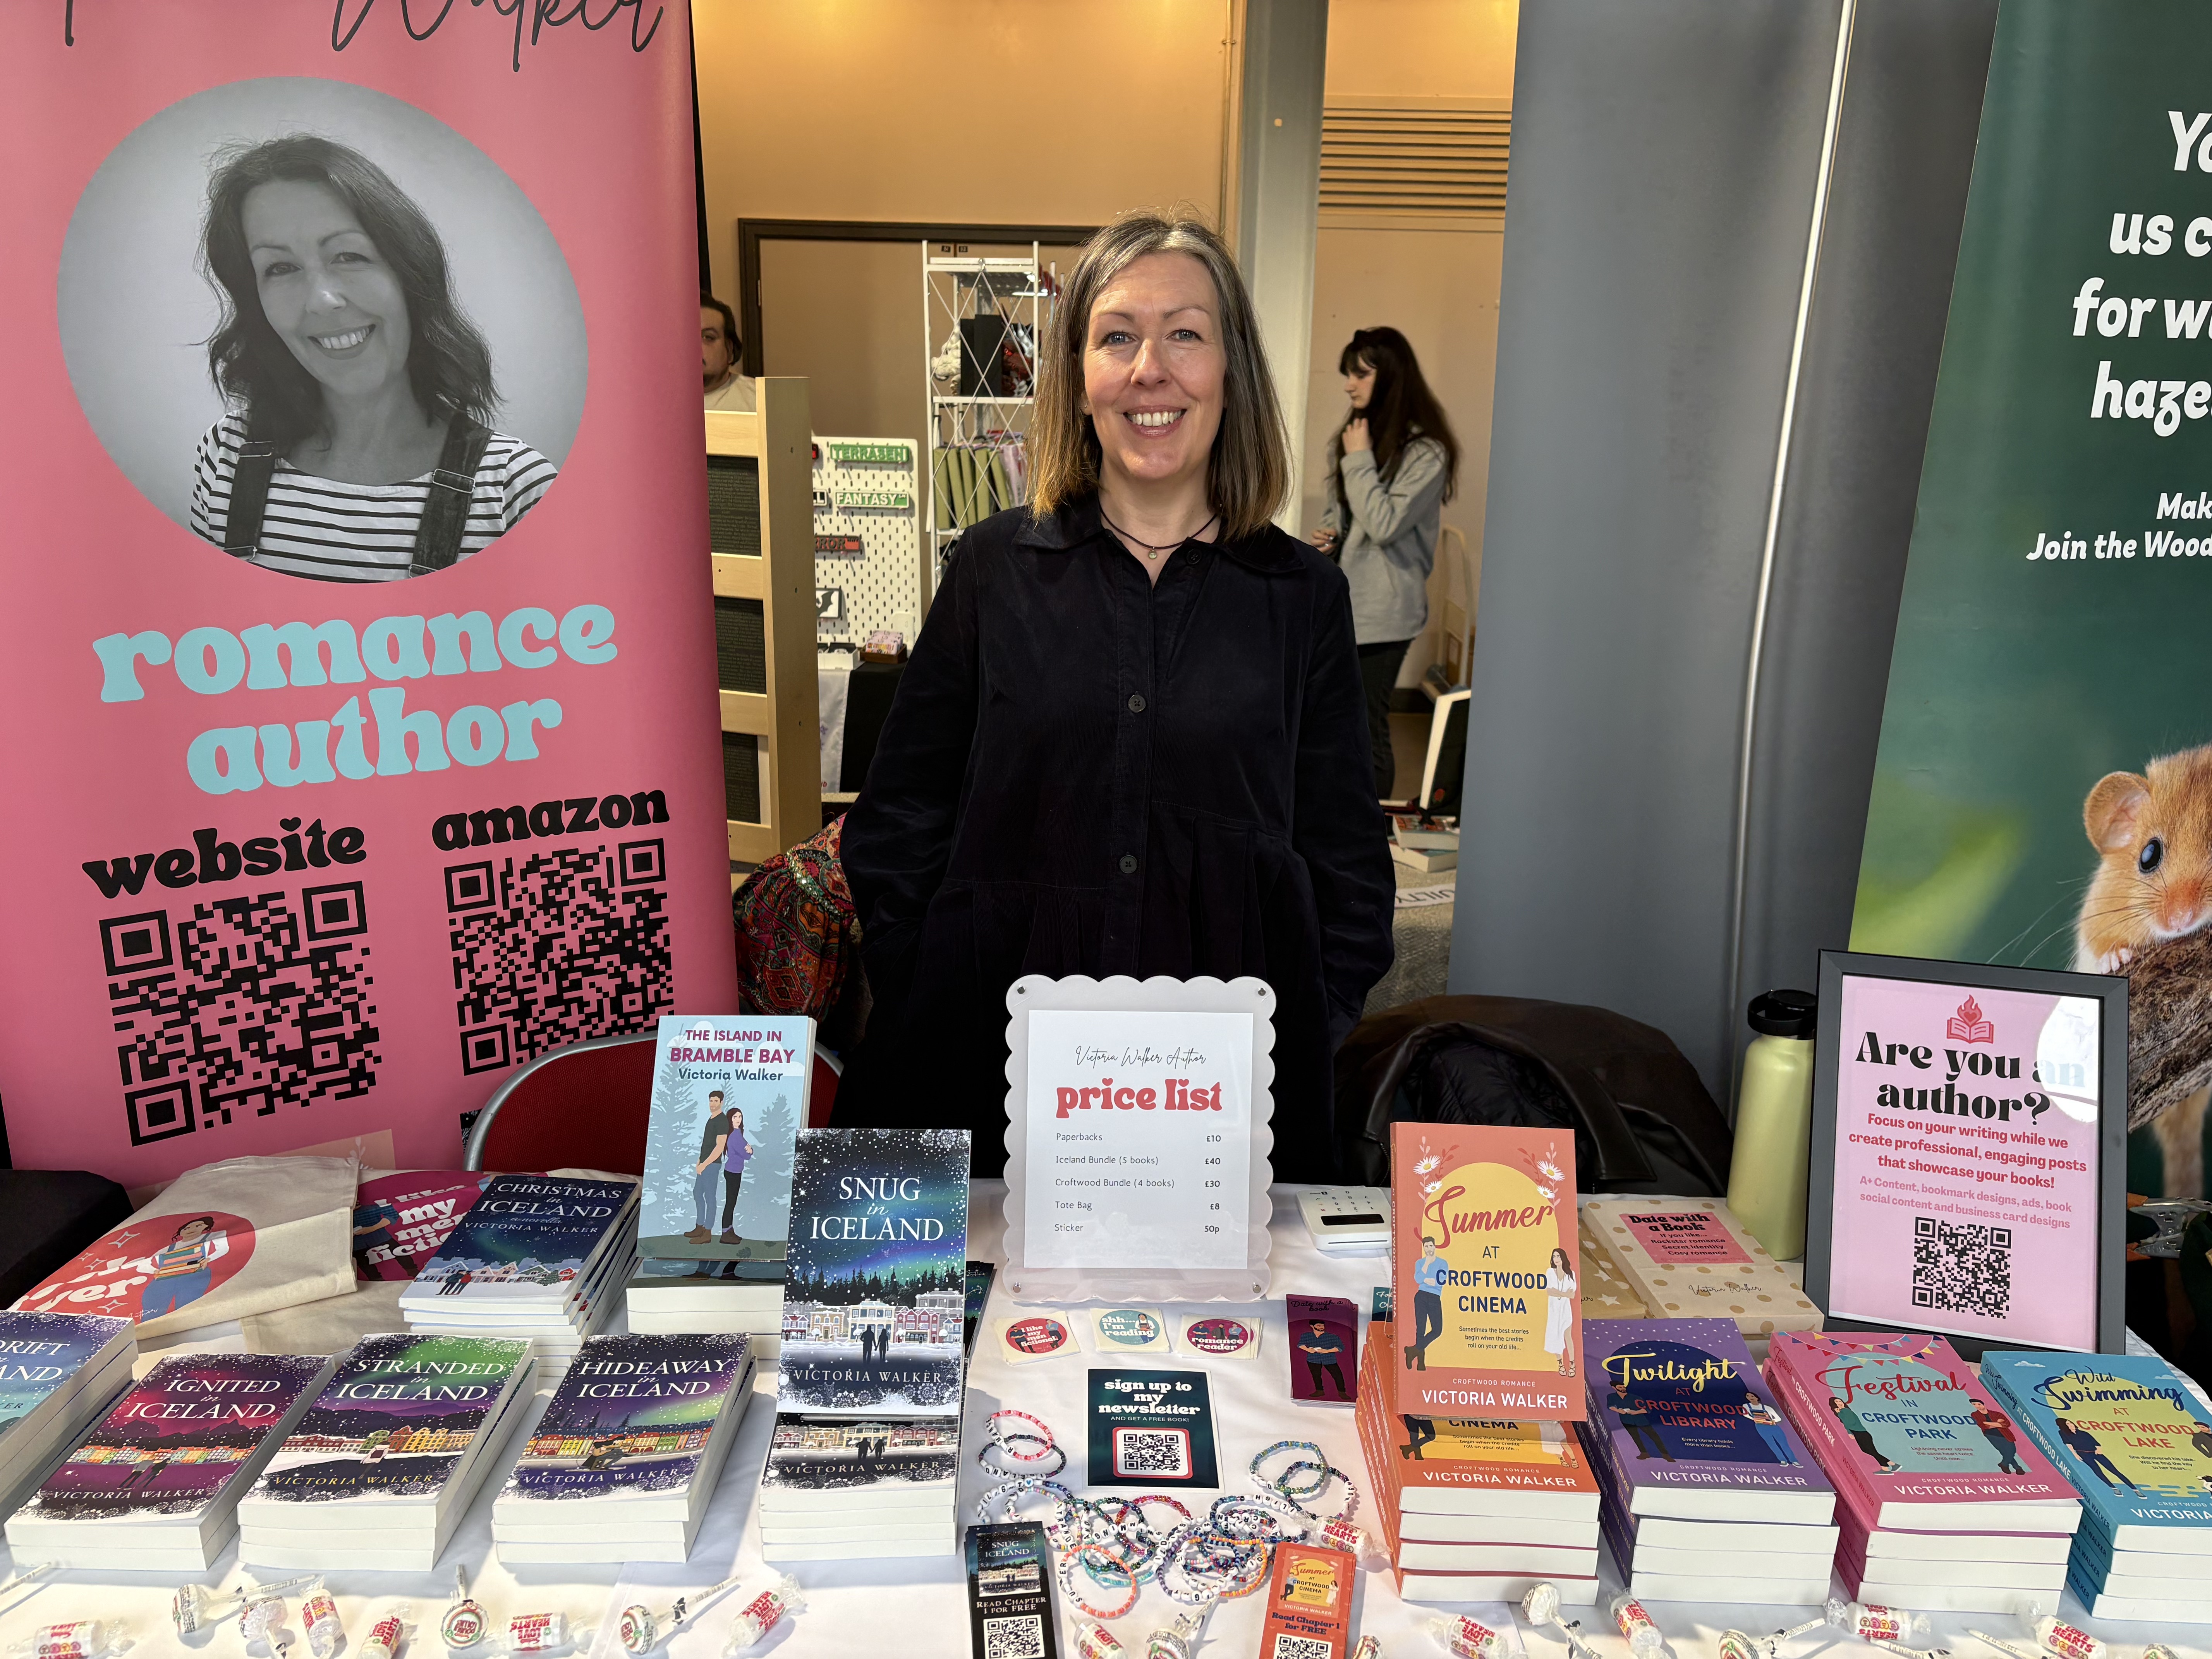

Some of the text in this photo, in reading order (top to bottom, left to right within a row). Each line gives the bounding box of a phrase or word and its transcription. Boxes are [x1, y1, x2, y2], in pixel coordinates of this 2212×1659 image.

[2109, 213, 2172, 255] us
[2073, 277, 2156, 338] for
[2090, 361, 2212, 437] haze
[836, 493, 896, 505] FANTASY
[2026, 532, 2087, 560] Join
[2094, 532, 2137, 559] the
[93, 604, 617, 702] romance
[187, 687, 562, 795] author
[432, 789, 670, 851] amazon
[82, 818, 367, 899] website
[685, 1030, 782, 1042] THE ISLAND IN
[670, 1048, 795, 1063] BRAMBLE BAY
[1076, 1045, 1206, 1070] Victoria Walker Author
[1855, 1032, 2086, 1088] Are you an
[678, 1068, 783, 1081] Victoria Walker
[1056, 1078, 1222, 1118] price list
[1876, 1082, 2051, 1126] author?
[1056, 1133, 1102, 1142] Paperbacks
[1868, 1113, 2068, 1149] Focus on your writing while we
[1849, 1133, 2087, 1171] create professional, engaging posts
[1056, 1156, 1085, 1164] Iceland
[1089, 1156, 1116, 1164] Bundle
[1119, 1156, 1127, 1165] (5
[1130, 1156, 1158, 1165] books)
[1877, 1155, 2055, 1189] that showcase your books!
[497, 1183, 622, 1199] CHRISTMAS
[839, 1176, 921, 1200] SNUG
[1055, 1178, 1100, 1187] Croftwood
[1104, 1178, 1131, 1187] Bundle
[1134, 1179, 1143, 1188] (4
[1146, 1179, 1175, 1188] books)
[1860, 1176, 2072, 1212] A+ Content, bookmark designs, ads, book
[398, 1198, 457, 1225] my
[476, 1200, 612, 1218] ICELAND
[867, 1203, 889, 1216] in
[1055, 1201, 1074, 1209] Tote
[1078, 1201, 1092, 1211] Bag
[1860, 1193, 2070, 1229] social content and business card designs
[1414, 1185, 1553, 1249] Summer
[1669, 1214, 1711, 1222] with
[810, 1216, 944, 1241] ICELAND
[1054, 1224, 1219, 1234] Sticker 50p
[1659, 1223, 1705, 1231] Book
[1482, 1245, 1500, 1259] AT
[1436, 1269, 1547, 1290] CROFTWOOD
[1458, 1296, 1527, 1315] CINEMA
[1020, 1336, 1058, 1346] fictional.
[353, 1360, 504, 1375] STRANDED
[579, 1359, 732, 1375] HIDEAWAY
[1601, 1353, 1745, 1392] Twilight
[2064, 1365, 2115, 1384] Wild
[795, 1369, 942, 1384] VICTORIA WALKER
[1815, 1365, 1967, 1404] Festival
[164, 1379, 281, 1393] IGNITED
[334, 1384, 488, 1401] ICELAND
[577, 1382, 710, 1398] ICELAND
[1104, 1379, 1192, 1393] sign up to
[1675, 1387, 1690, 1396] AT
[2031, 1376, 2185, 1411] Swimming
[1134, 1394, 1164, 1405] my
[1422, 1389, 1567, 1409] VICTORIA WALKER
[1901, 1399, 1918, 1408] IN
[124, 1403, 275, 1419] ICELAND
[1099, 1401, 1200, 1415] newsletter
[1635, 1399, 1749, 1416] CROFTWOOD
[1659, 1414, 1736, 1430] LIBRARY
[1862, 1412, 1977, 1426] CROFTWOOD
[1905, 1428, 1958, 1440] PARK
[2076, 1420, 2195, 1435] CROFTWOOD
[2123, 1436, 2175, 1449] LAKE
[275, 1475, 433, 1486] VICTORIA WALKER
[2052, 1626, 2093, 1653] HEARTS
[2065, 1626, 2090, 1642] LOVE
